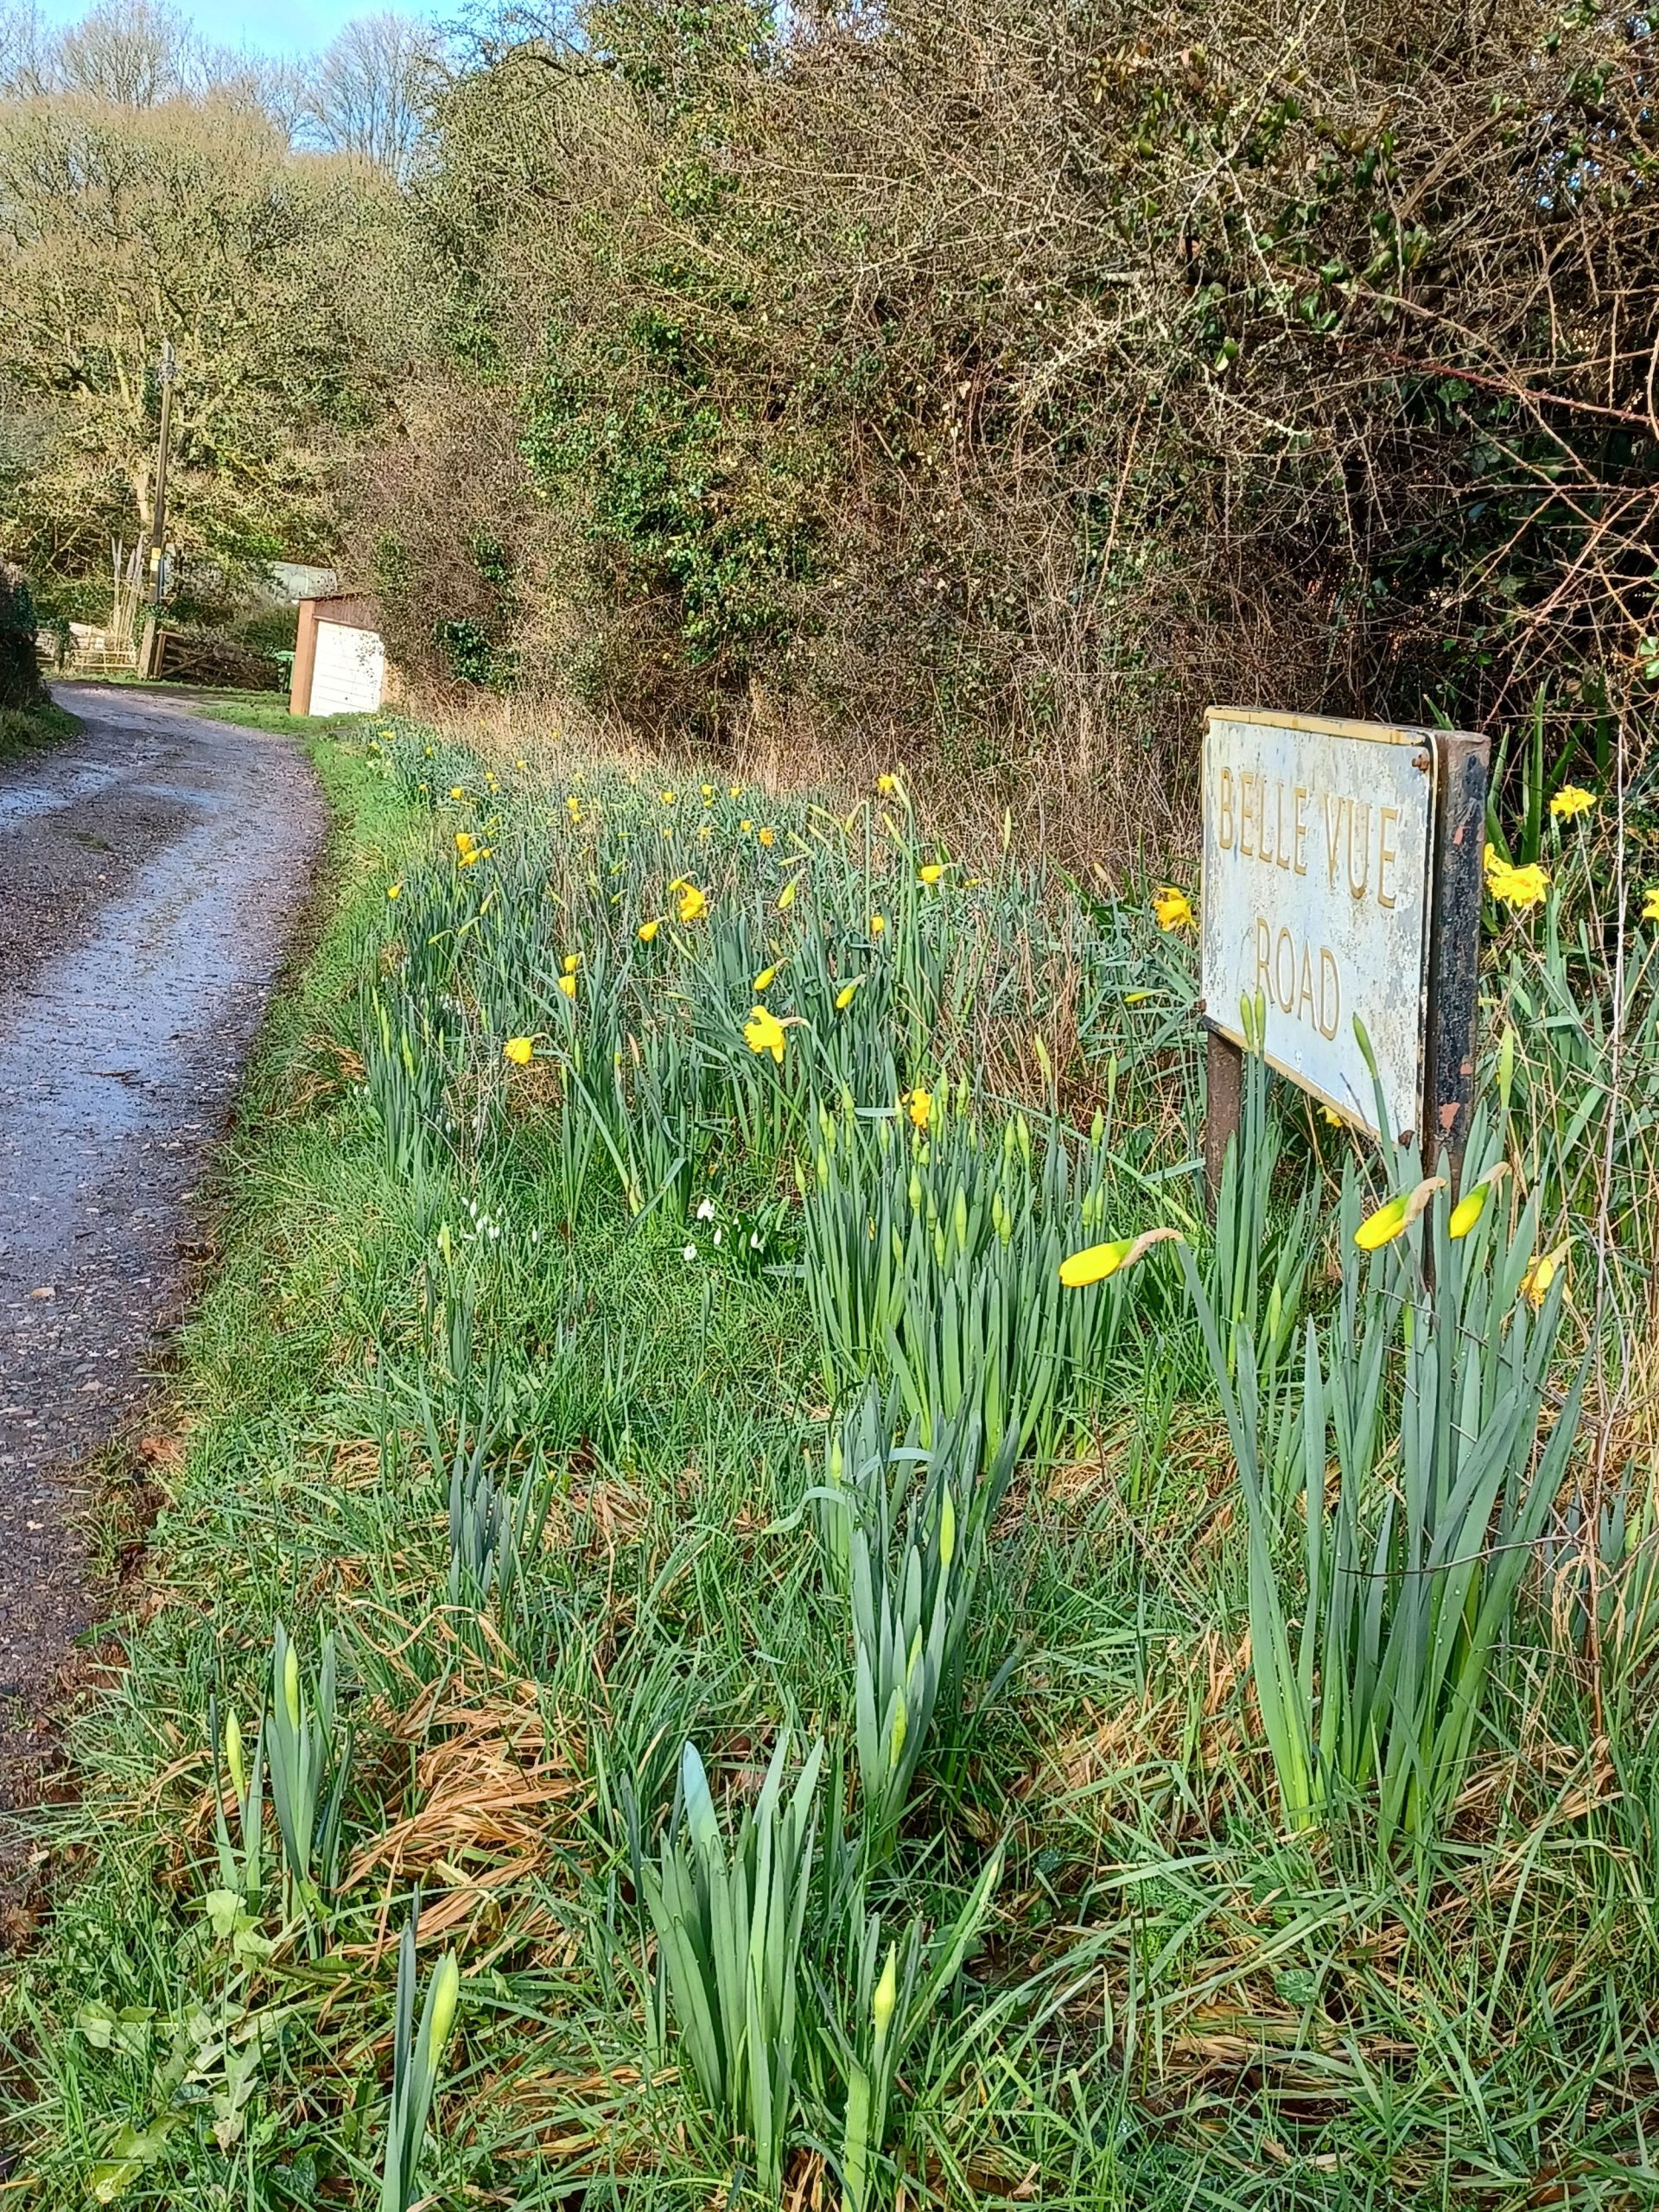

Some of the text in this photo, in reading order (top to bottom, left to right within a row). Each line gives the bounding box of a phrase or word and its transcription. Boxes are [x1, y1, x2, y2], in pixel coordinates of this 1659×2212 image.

[1218, 766, 1398, 908] BELLE VUE
[1255, 918, 1341, 1040] ROAD
